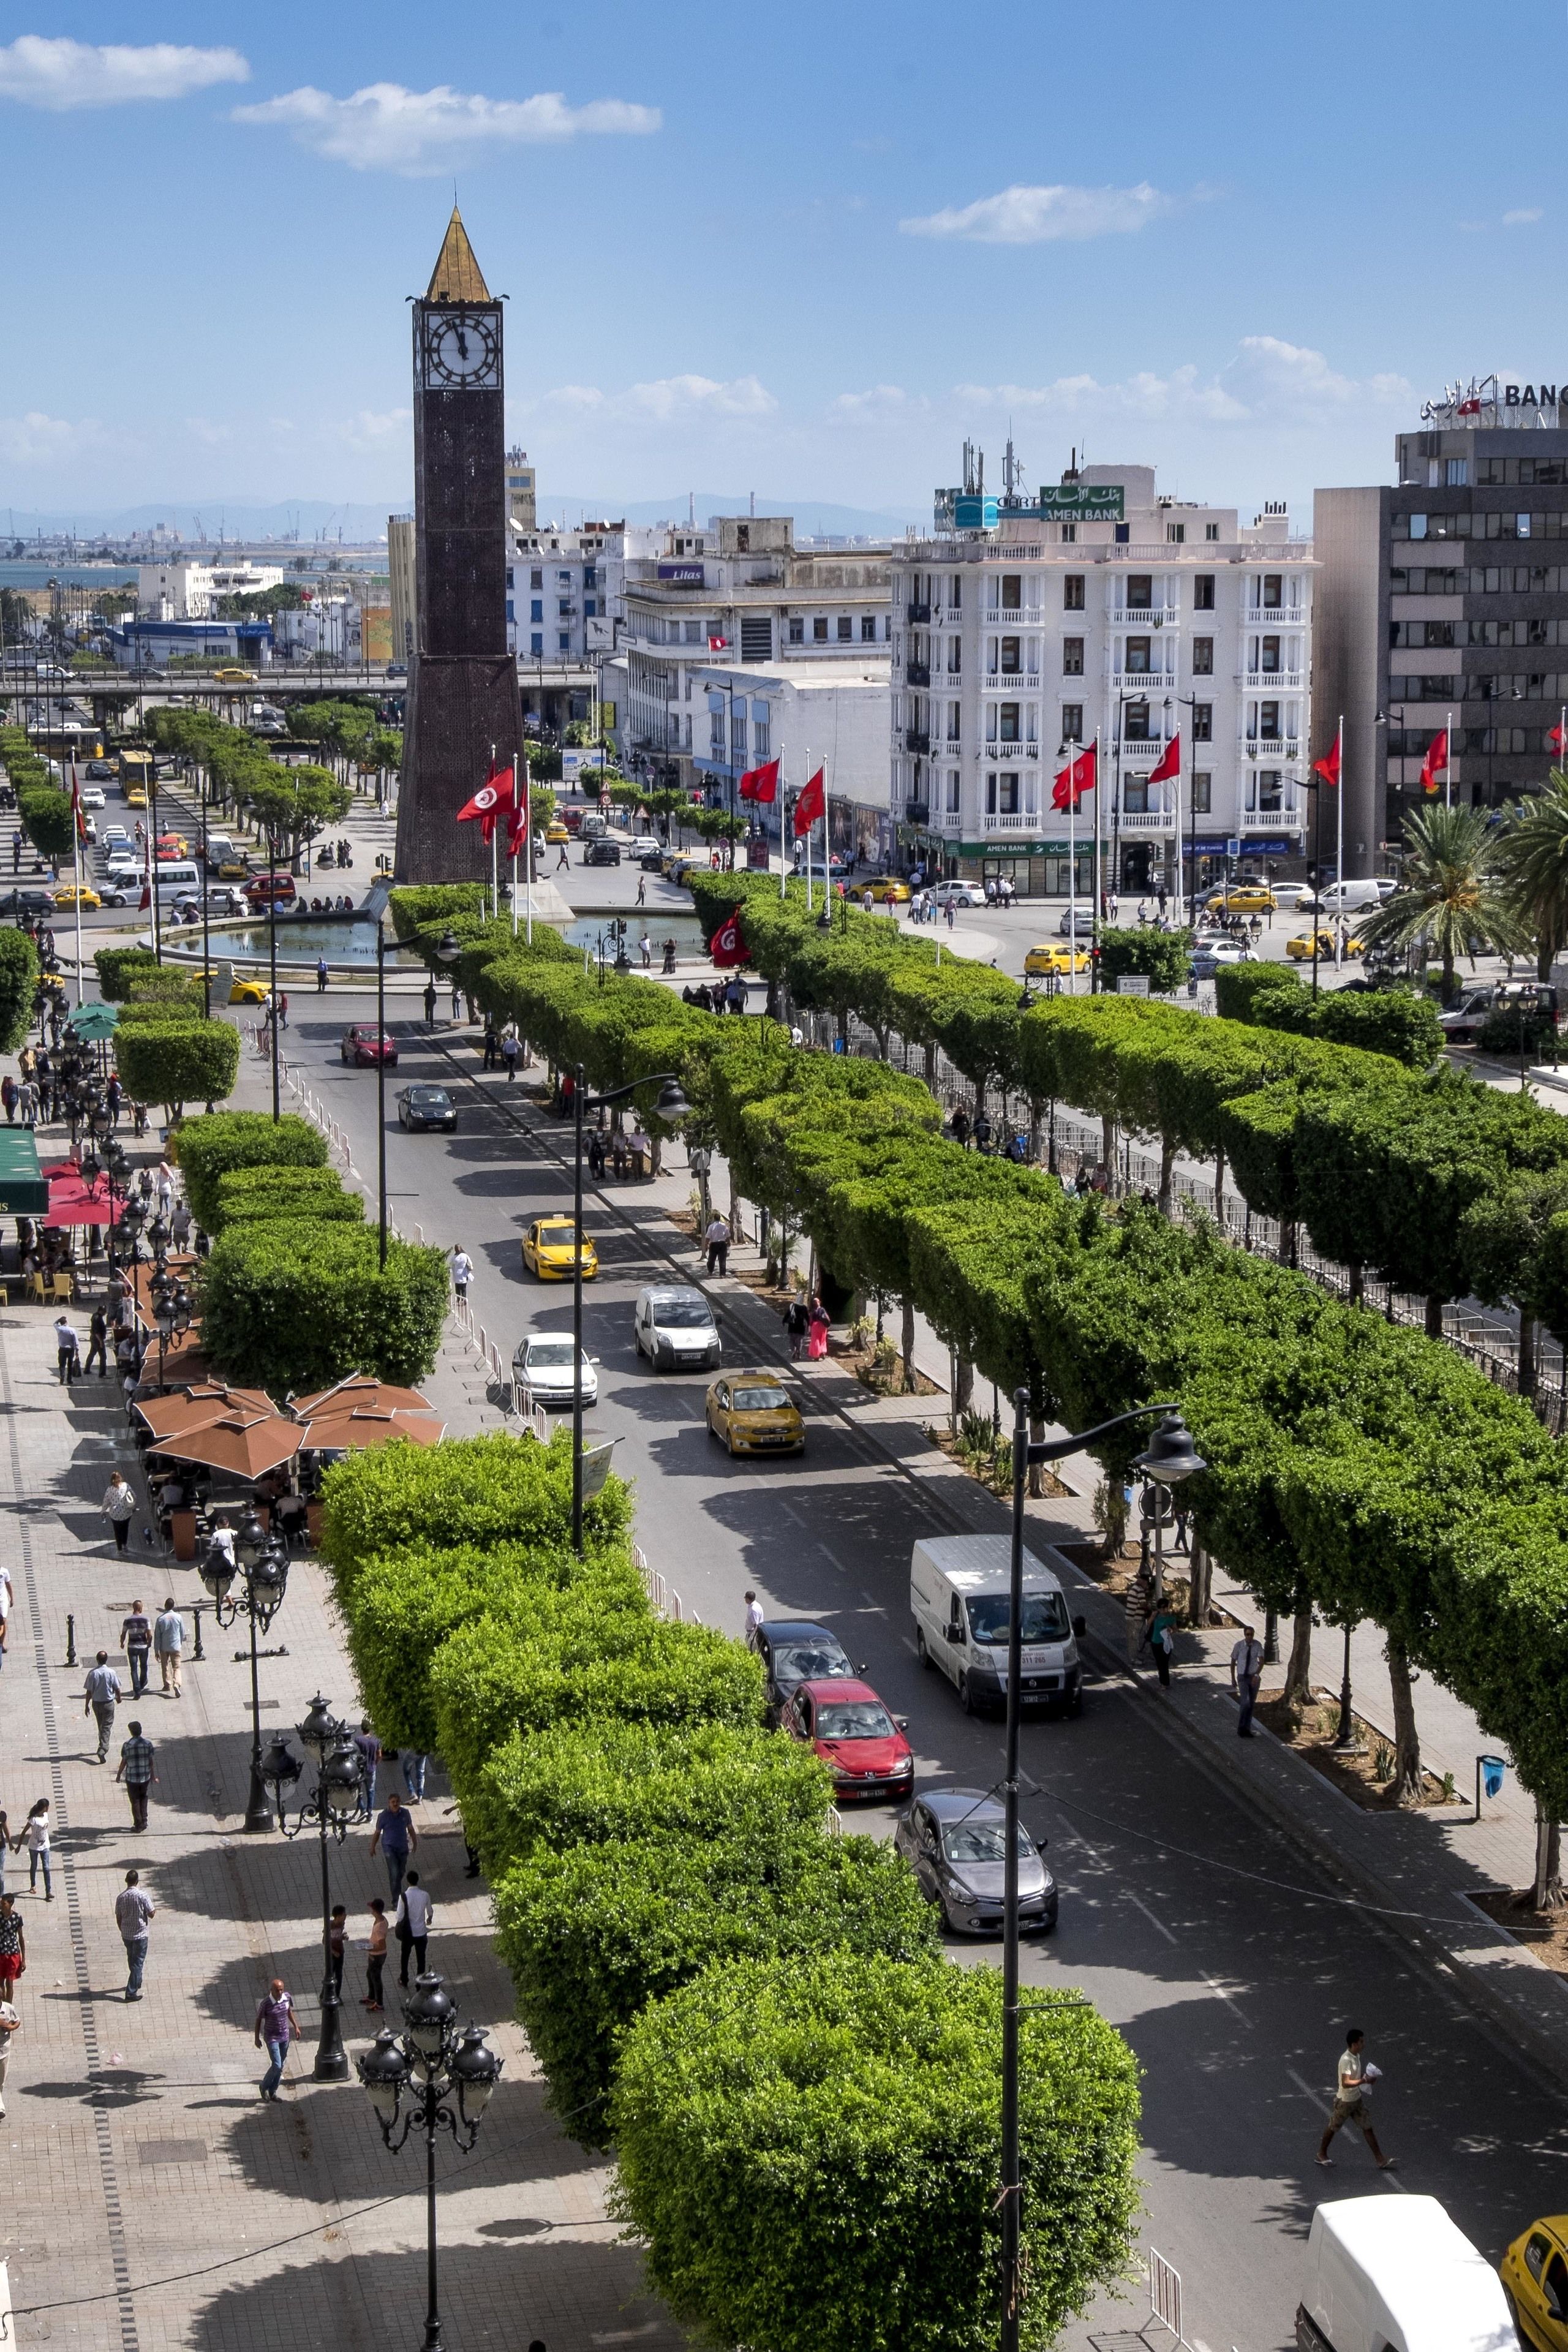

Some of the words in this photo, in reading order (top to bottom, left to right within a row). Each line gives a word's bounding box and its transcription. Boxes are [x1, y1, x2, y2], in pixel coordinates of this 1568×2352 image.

[1090, 488, 1120, 502] بنك
[1044, 509, 1081, 521] AMEN
[1085, 509, 1120, 521] BANK
[673, 570, 702, 580] Lilas
